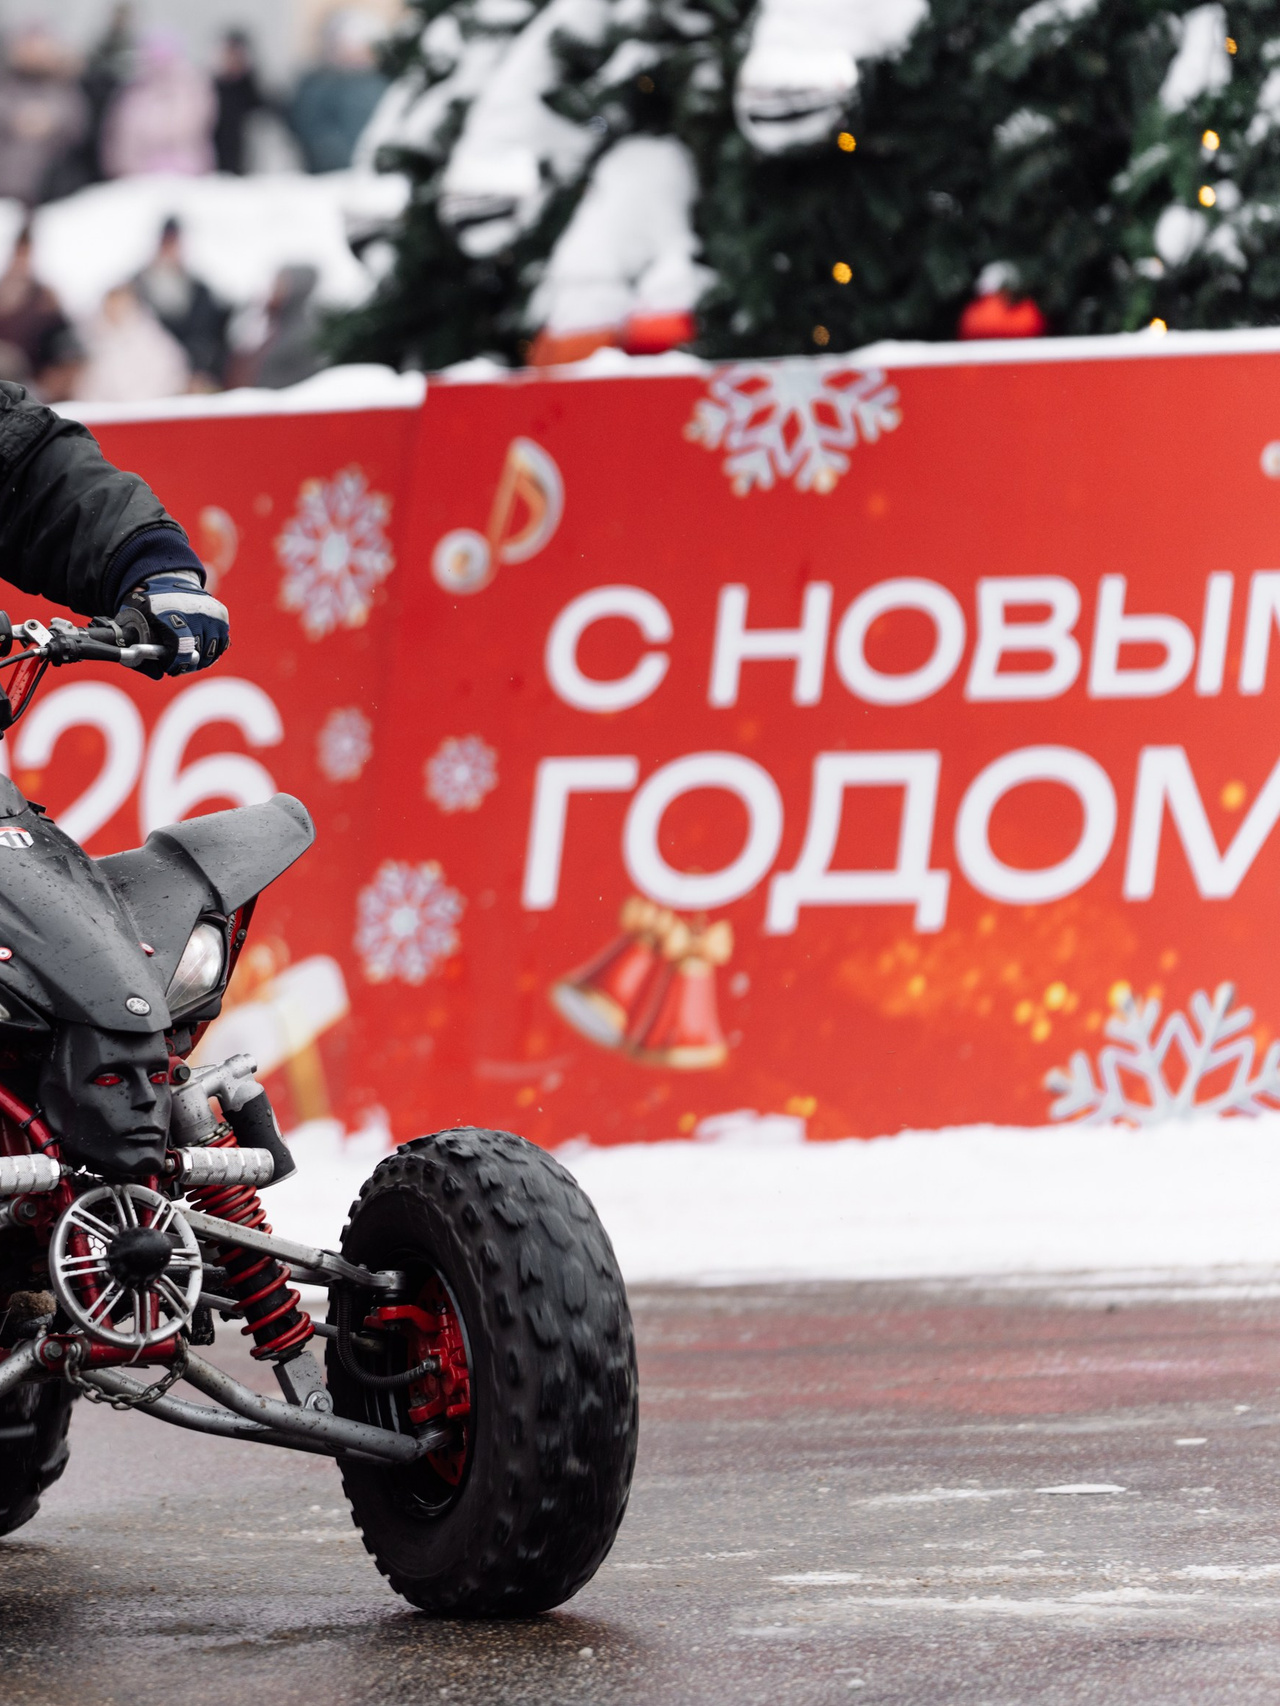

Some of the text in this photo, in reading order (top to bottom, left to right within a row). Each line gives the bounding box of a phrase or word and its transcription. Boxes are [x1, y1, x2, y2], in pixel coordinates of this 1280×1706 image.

[545, 569, 1280, 713] С НОВЫ
[521, 743, 1280, 936] ГОДОМ
